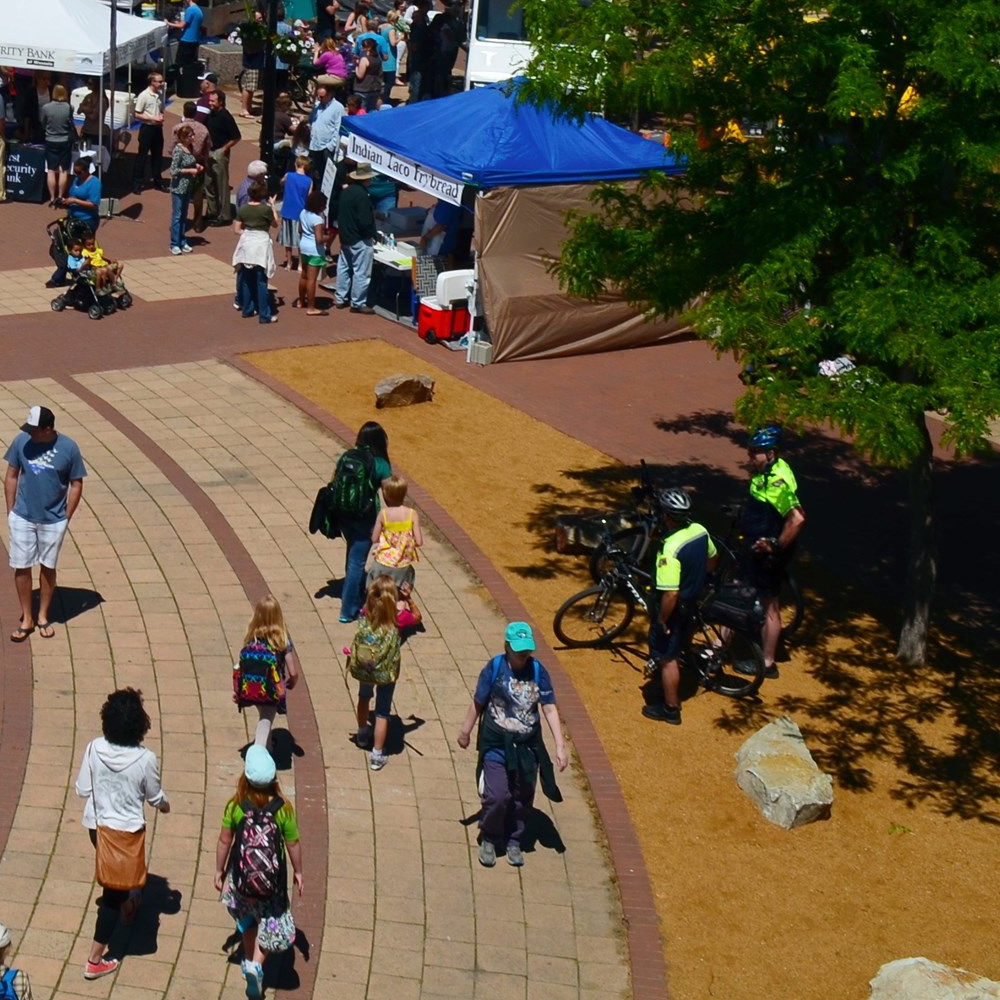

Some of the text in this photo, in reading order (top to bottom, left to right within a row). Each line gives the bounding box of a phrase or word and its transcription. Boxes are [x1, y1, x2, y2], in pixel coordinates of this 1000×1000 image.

[27, 47, 56, 60] BANK
[8, 153, 20, 162] rst
[351, 136, 459, 199] Indian Taco Frybread
